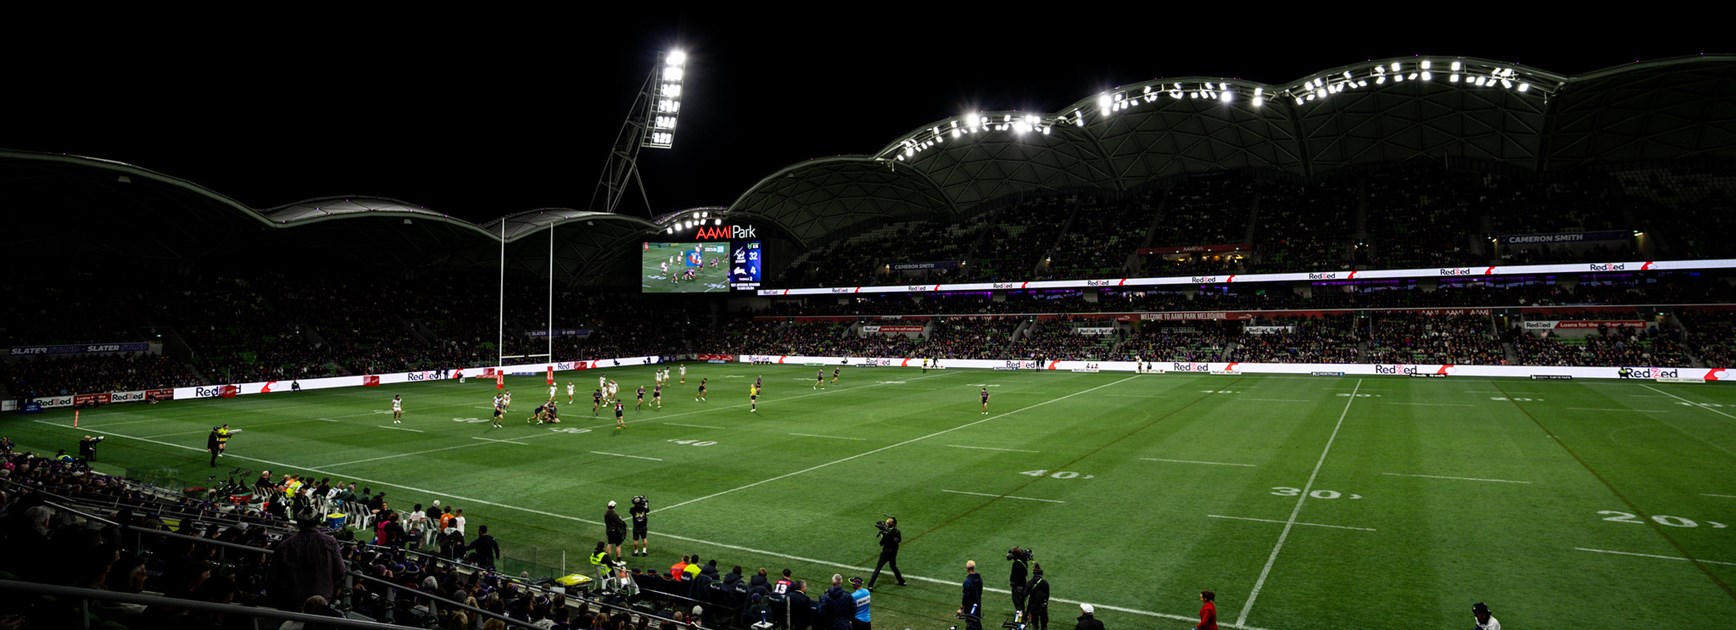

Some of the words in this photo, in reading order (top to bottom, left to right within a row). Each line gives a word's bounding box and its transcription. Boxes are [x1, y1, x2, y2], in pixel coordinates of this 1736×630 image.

[696, 226, 731, 240] AAMI
[732, 225, 757, 239] Park
[1509, 236, 1554, 244] CAMERON
[1554, 234, 1583, 242] SMITH
[749, 252, 758, 260] 32
[750, 266, 756, 275] 4
[1440, 268, 1470, 276] RedZed
[1590, 263, 1624, 271] RedZed
[1309, 272, 1335, 280] RedZed
[10, 347, 48, 355] SLATER
[1174, 362, 1209, 371] RedZed
[1375, 364, 1418, 375] RedZed
[1625, 367, 1678, 378] RedZed
[1019, 469, 1080, 479] 40
[1270, 486, 1341, 500] 30
[1597, 510, 1699, 528] 20
[775, 583, 787, 594] 13
